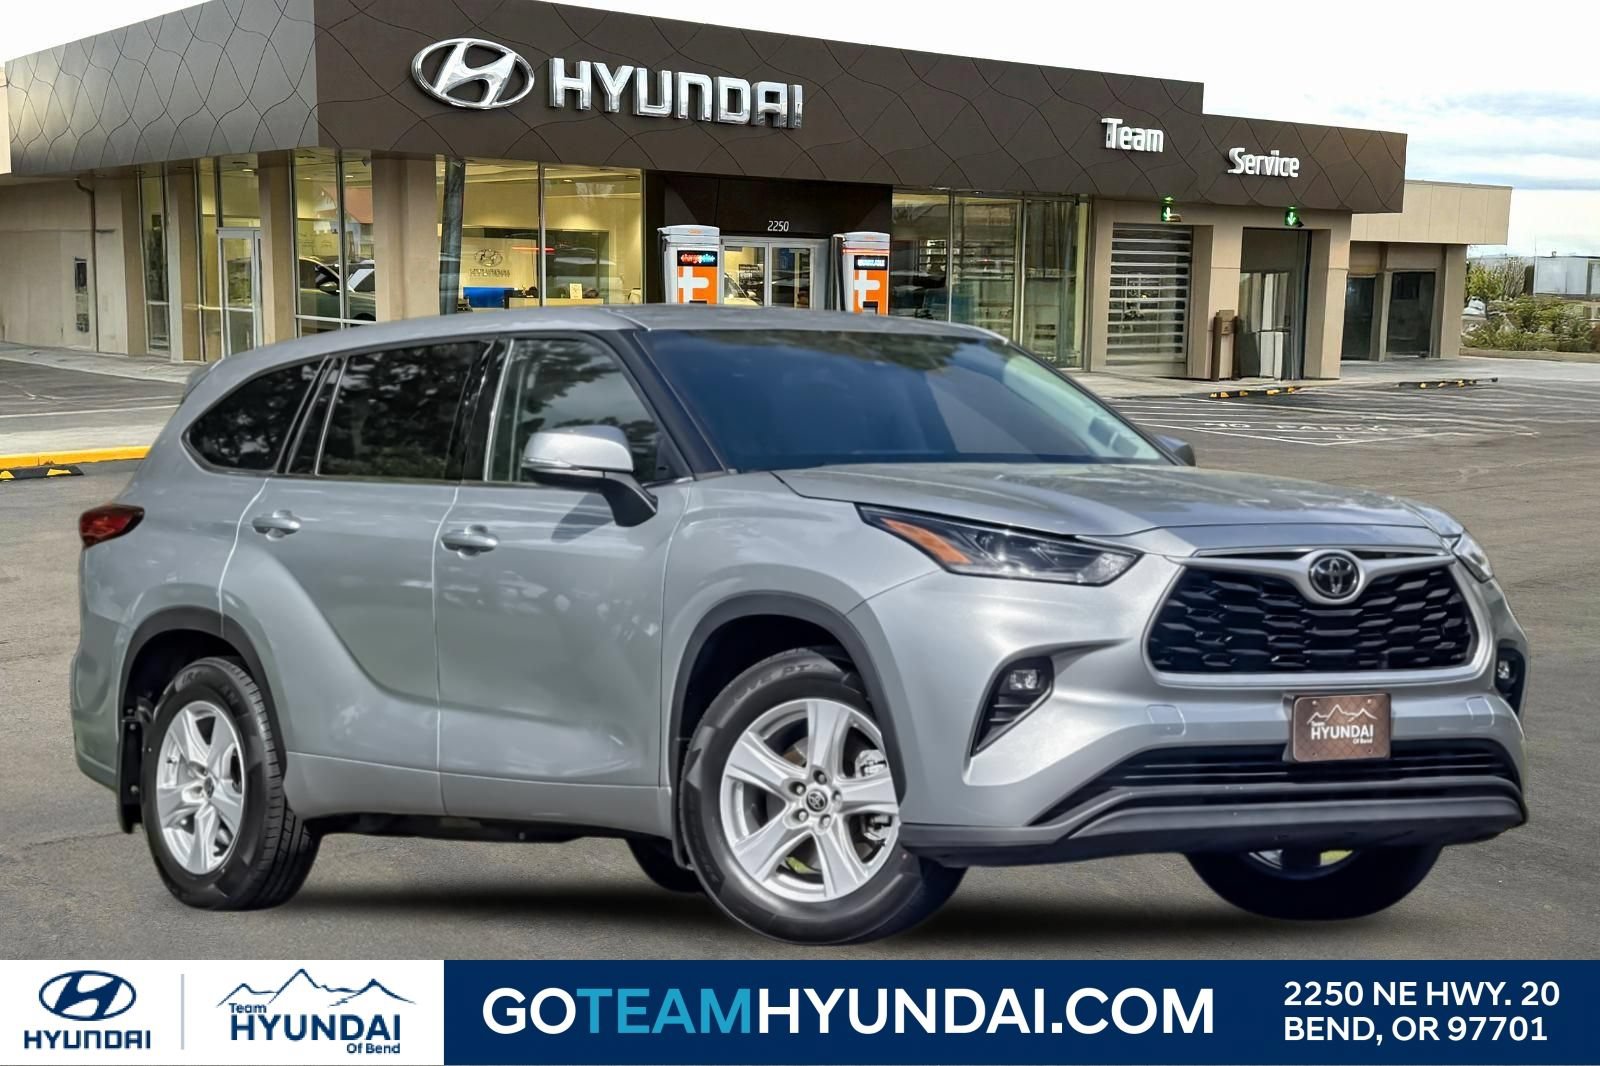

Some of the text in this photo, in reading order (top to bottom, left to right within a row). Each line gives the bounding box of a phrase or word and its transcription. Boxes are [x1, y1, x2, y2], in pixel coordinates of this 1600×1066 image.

[548, 57, 804, 129] HYUNDAI
[1101, 117, 1165, 153] Team
[1227, 147, 1300, 178] Service
[767, 220, 790, 232] 2250
[1311, 724, 1374, 740] HYUNDAI
